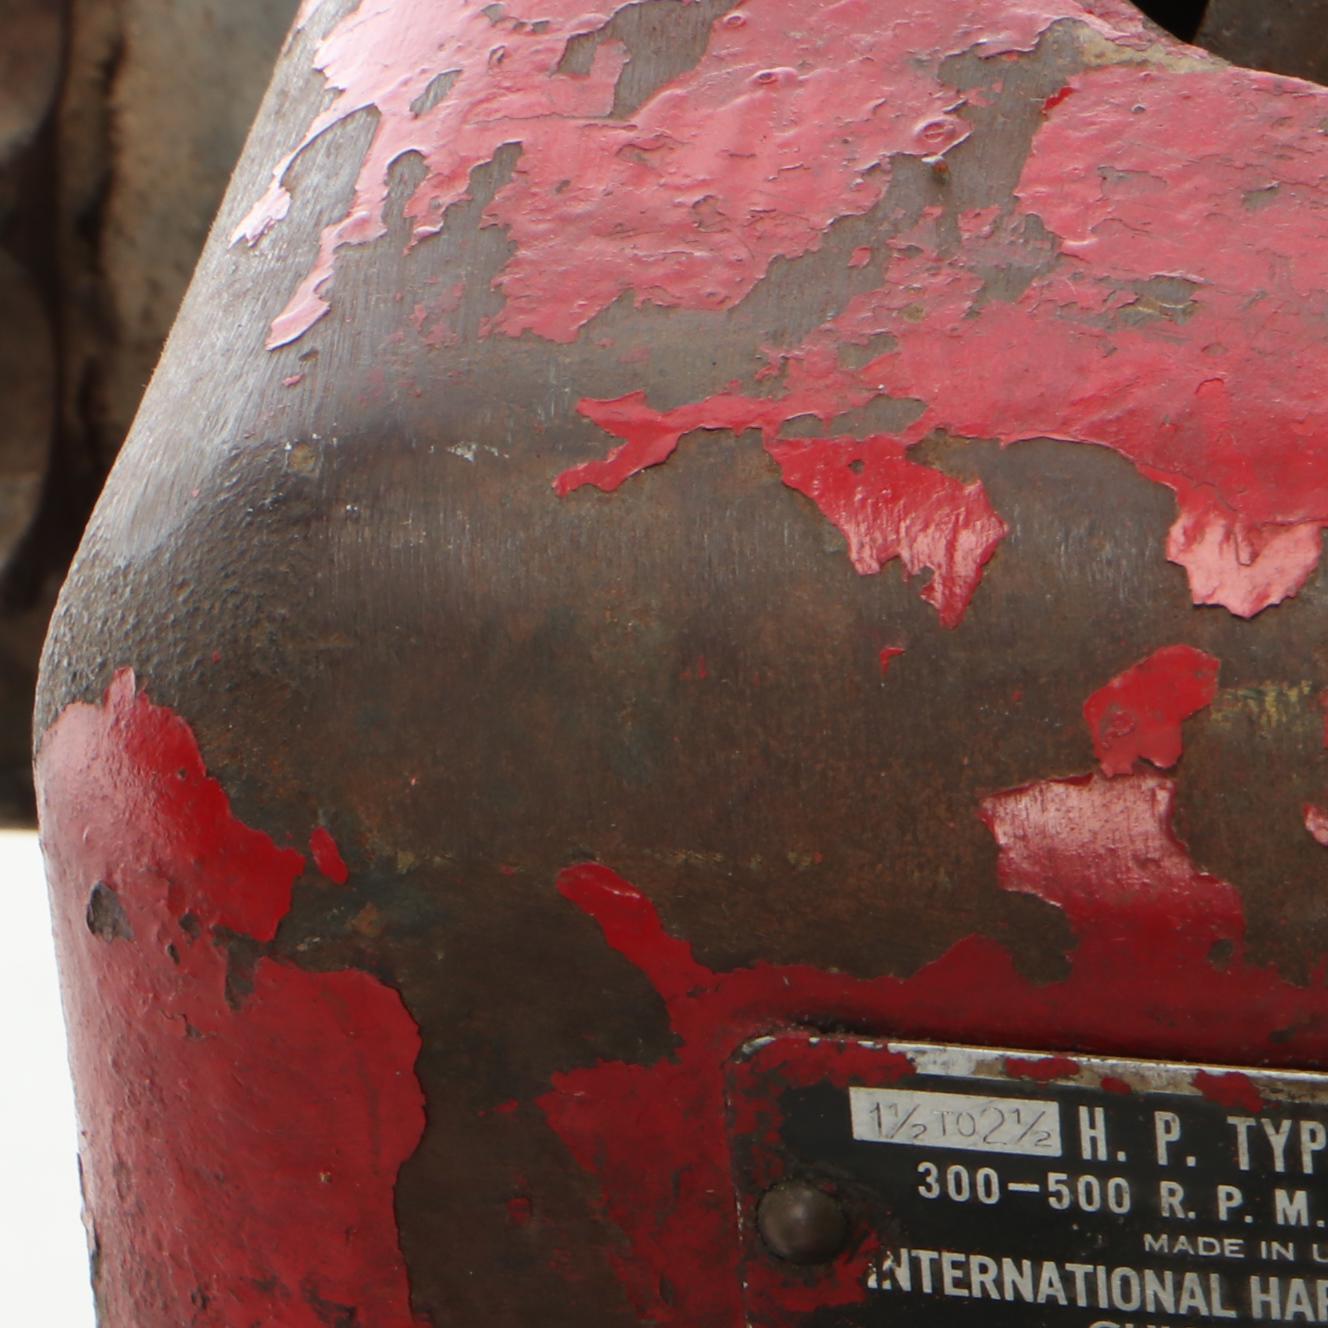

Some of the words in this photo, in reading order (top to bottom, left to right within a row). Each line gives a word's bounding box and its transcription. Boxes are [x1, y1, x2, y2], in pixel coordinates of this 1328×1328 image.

[1078, 1104, 1127, 1163] H.
[1154, 1110, 1197, 1168] P.
[1144, 1233, 1245, 1258] MADE
[1260, 1240, 1295, 1262] IN
